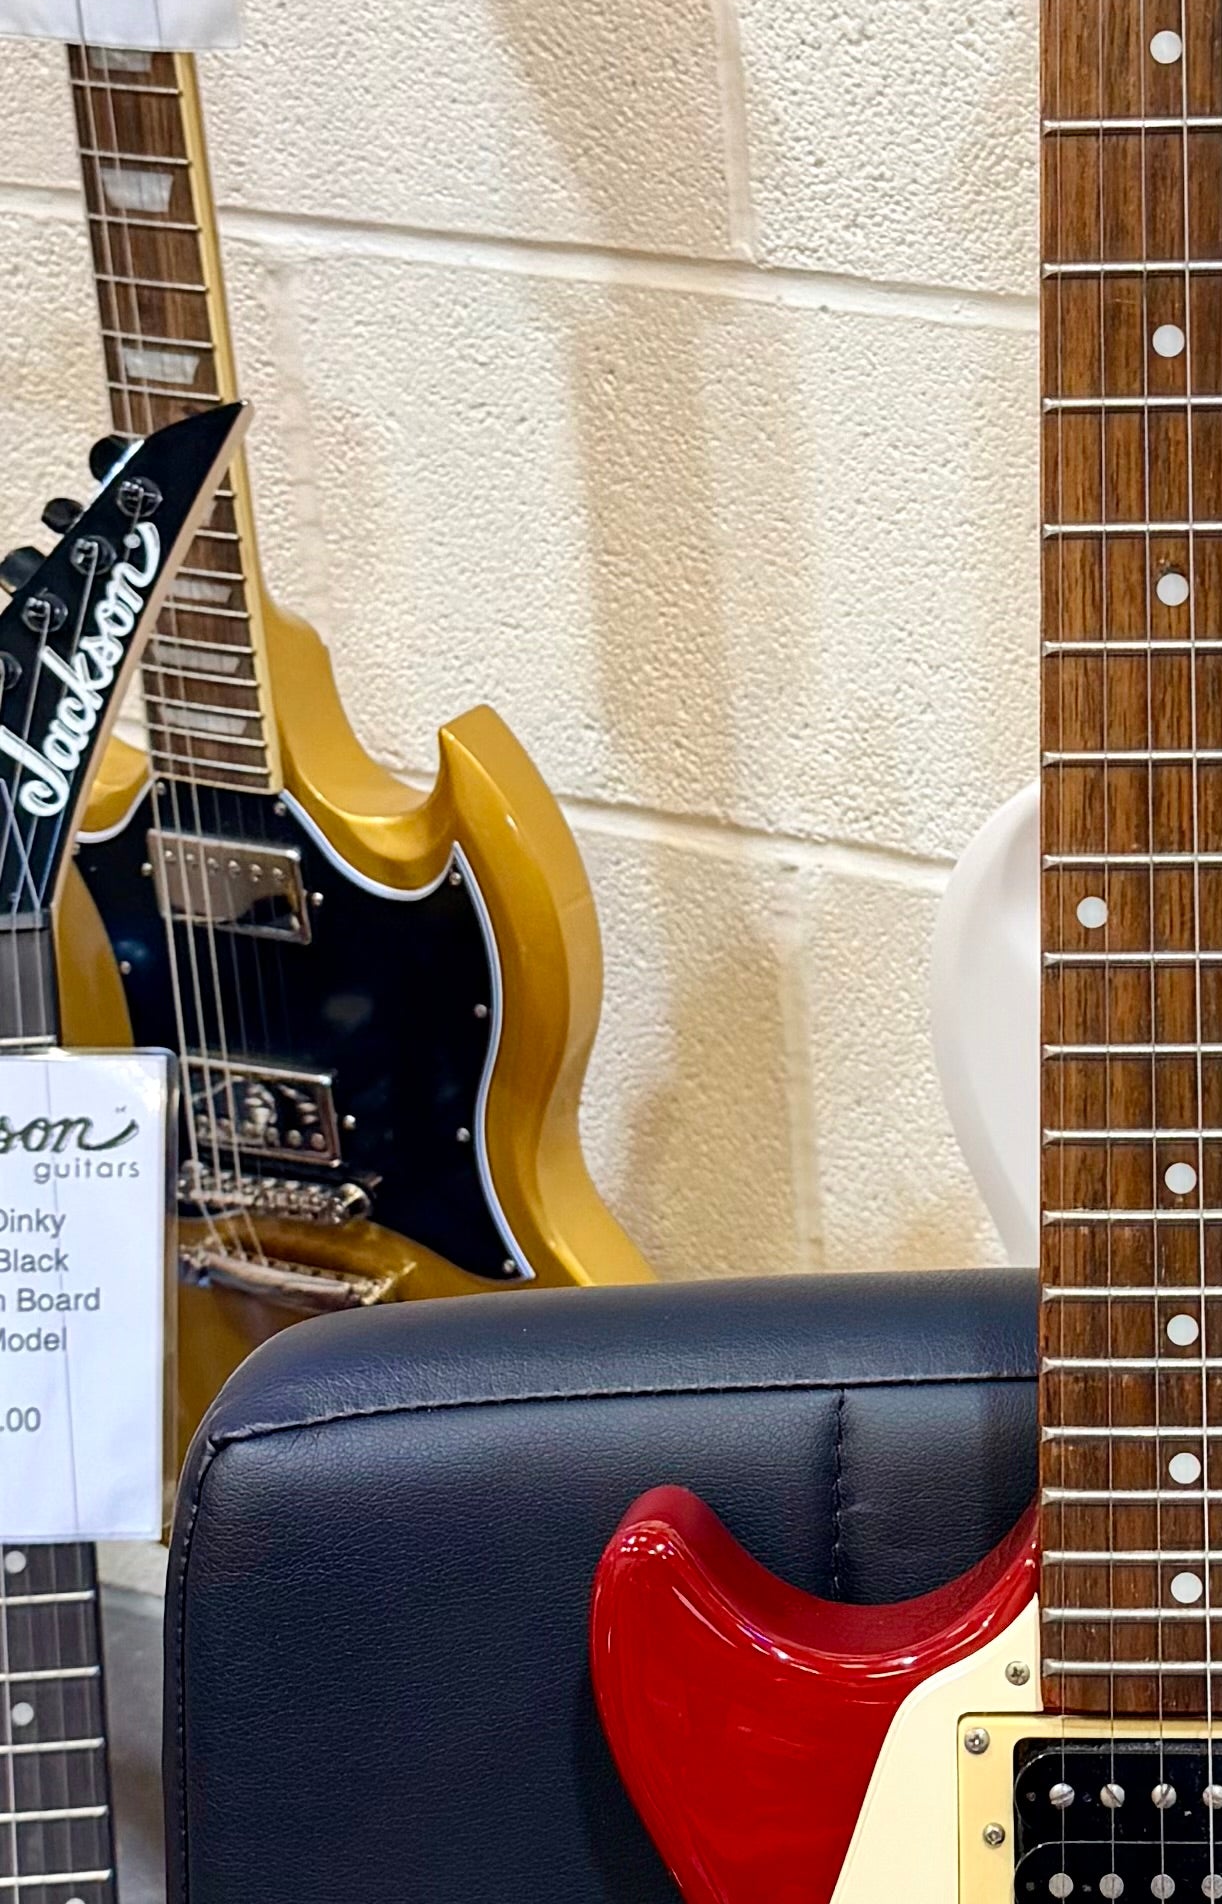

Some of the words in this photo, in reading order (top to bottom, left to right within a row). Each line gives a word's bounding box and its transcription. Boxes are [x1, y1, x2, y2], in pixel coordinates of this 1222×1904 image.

[0, 520, 161, 818] Jackson
[33, 1157, 141, 1185] guitars
[16, 1287, 101, 1313] Board
